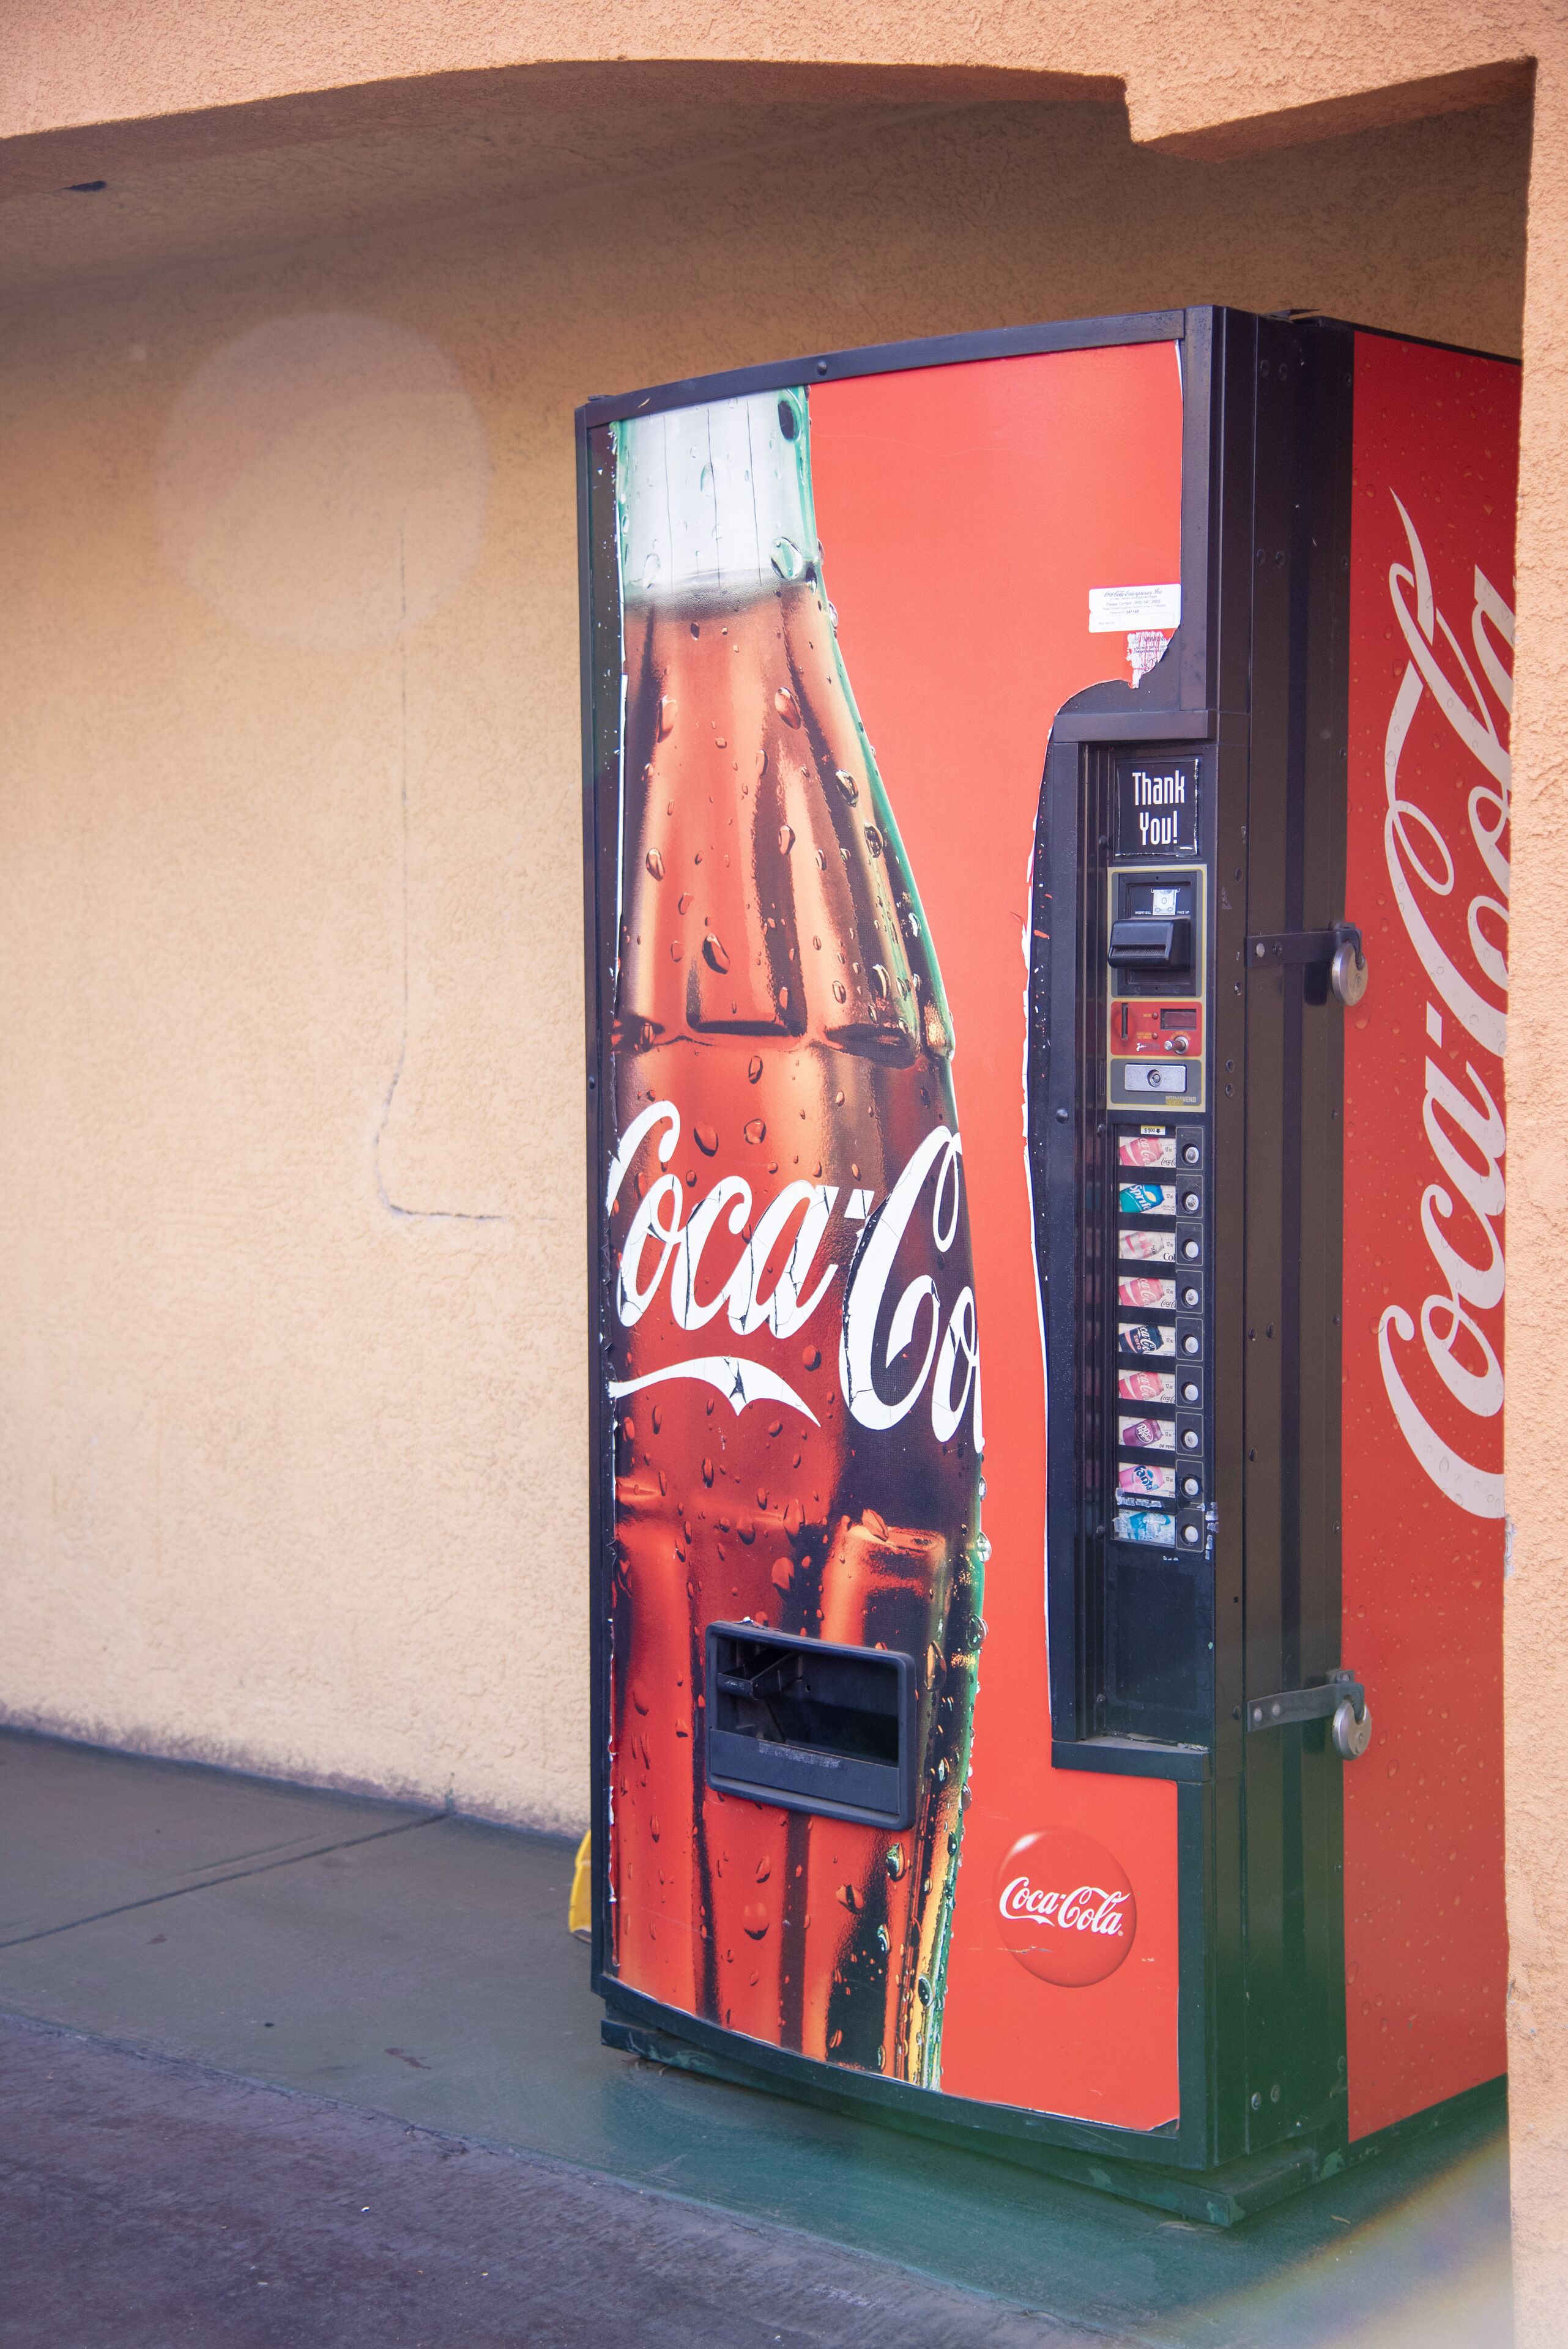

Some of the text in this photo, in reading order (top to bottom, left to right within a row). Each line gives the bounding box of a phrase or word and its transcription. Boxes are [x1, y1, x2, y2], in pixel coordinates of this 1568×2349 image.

[1132, 770, 1185, 806] Thank
[1139, 811, 1178, 845] You!
[1133, 1335, 1142, 1350] zero
[1134, 1465, 1153, 1491] Fanta
[999, 1876, 1131, 1935] Coca-Cola
